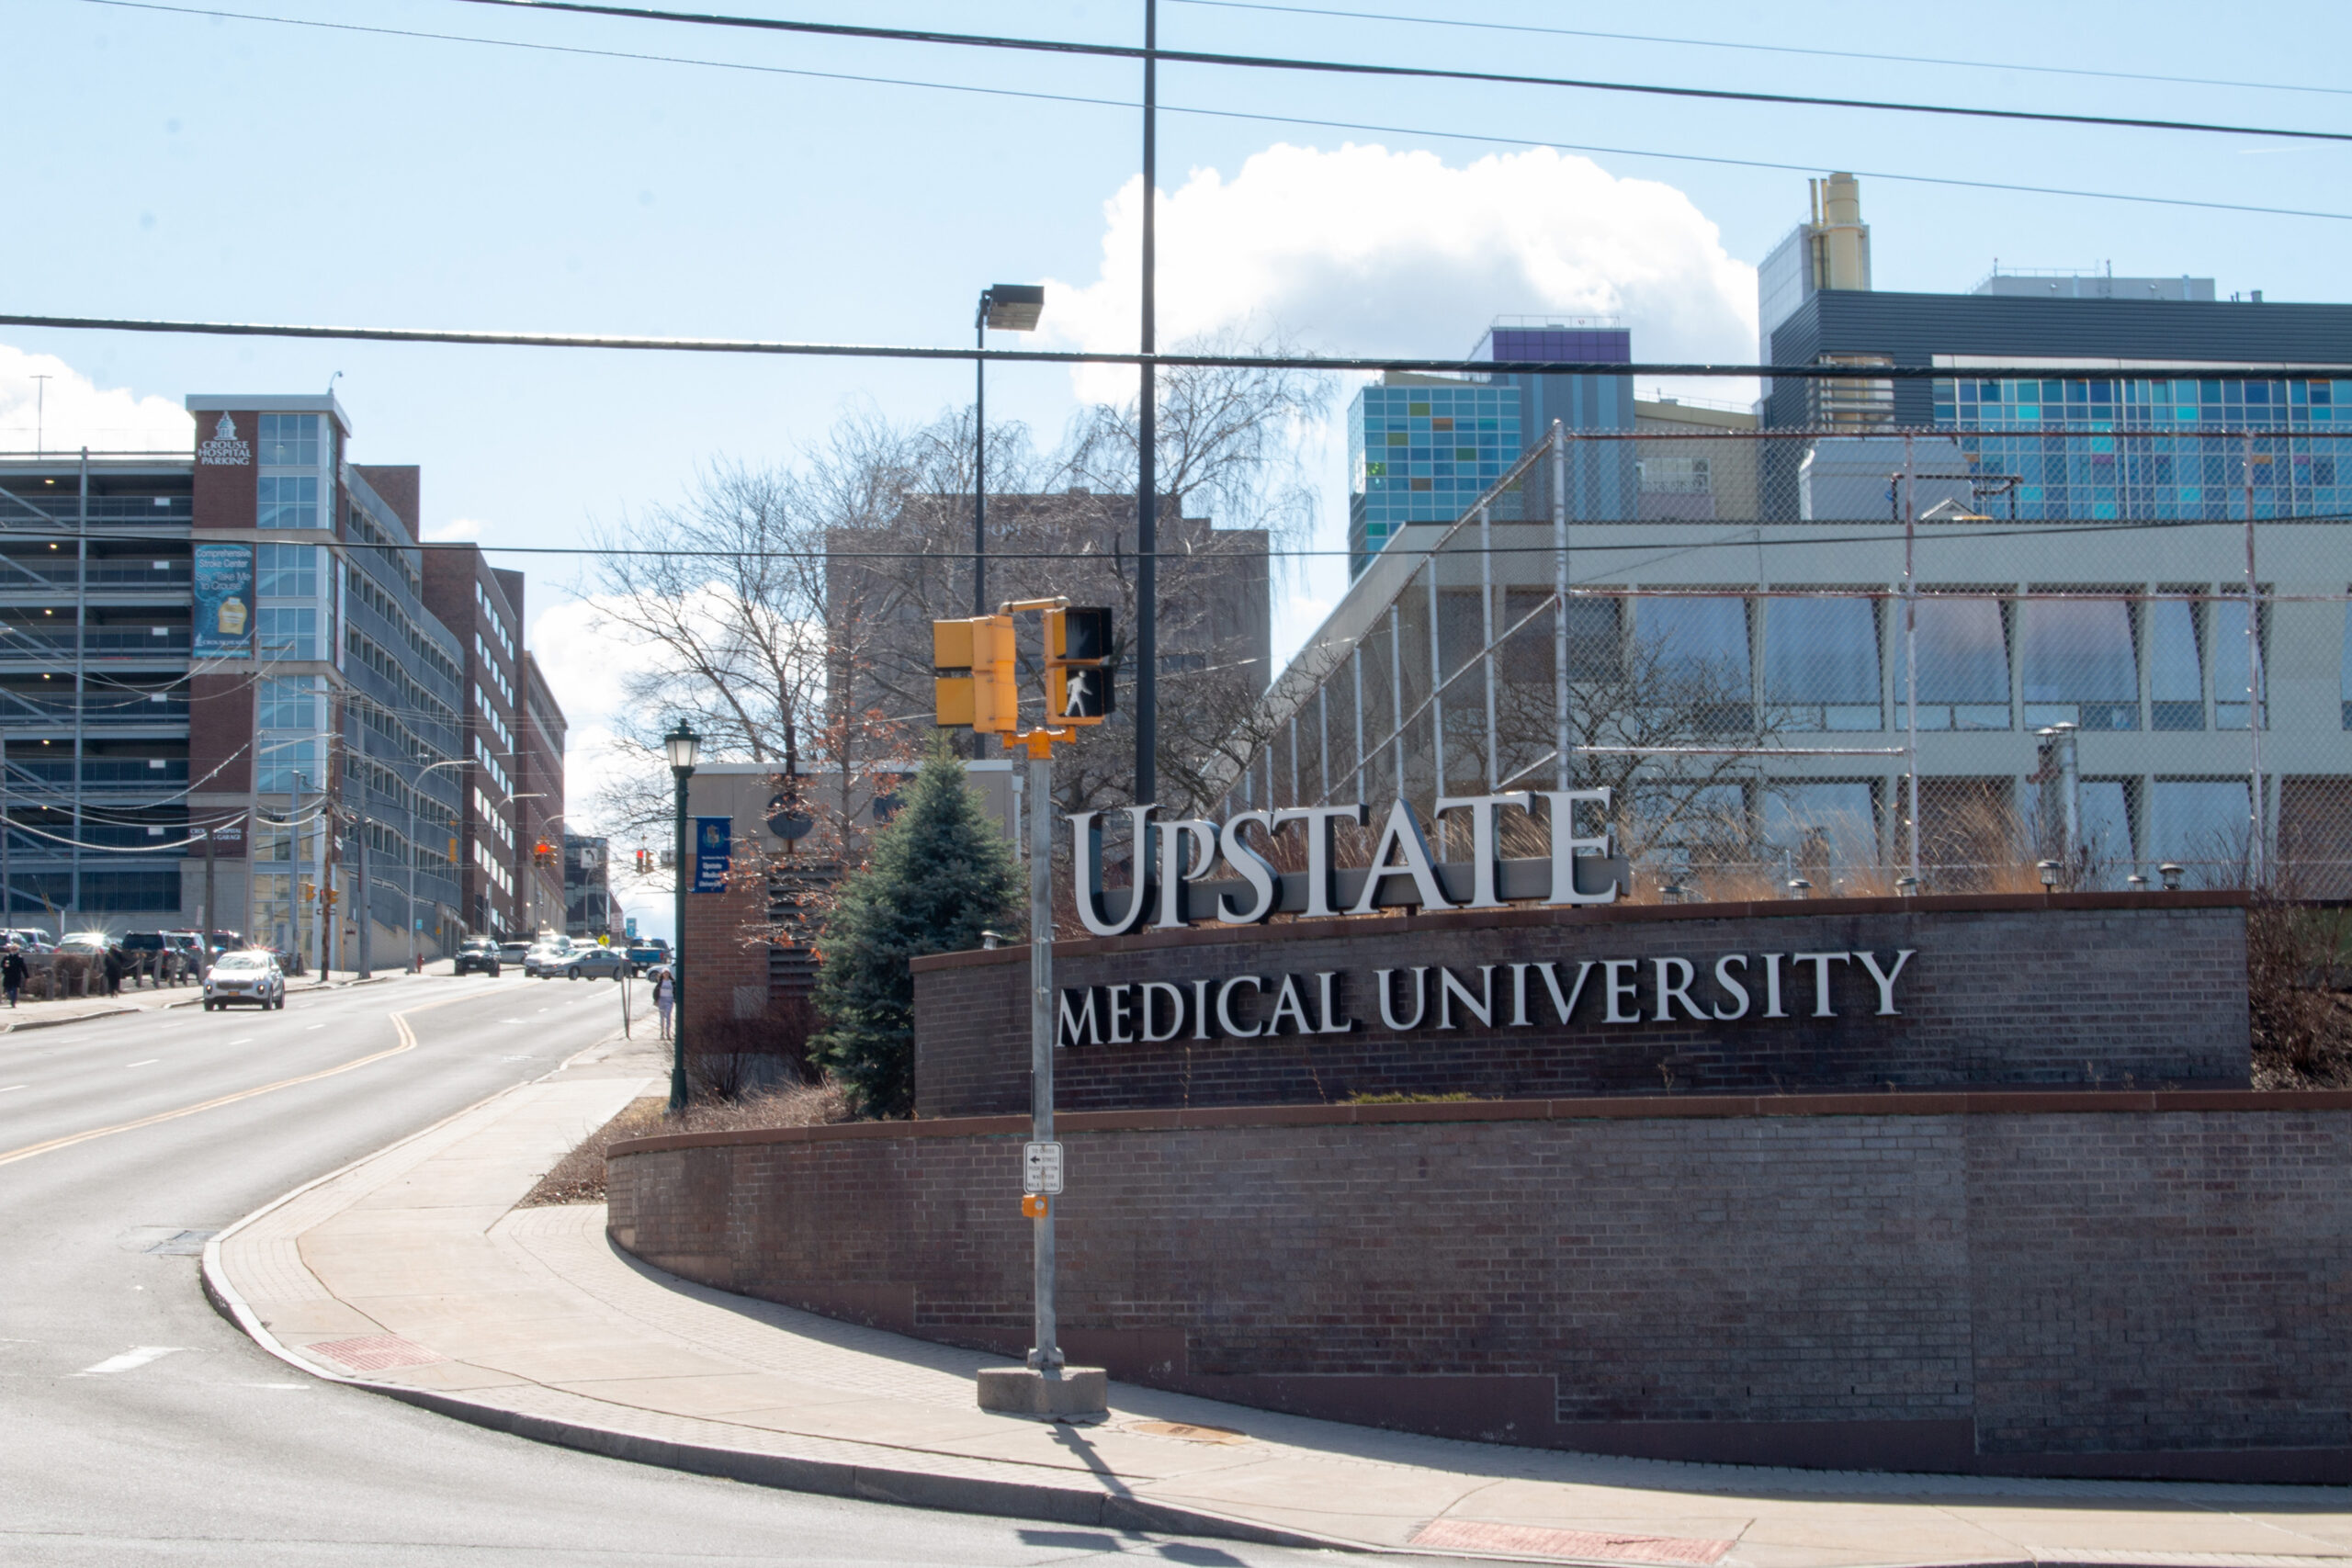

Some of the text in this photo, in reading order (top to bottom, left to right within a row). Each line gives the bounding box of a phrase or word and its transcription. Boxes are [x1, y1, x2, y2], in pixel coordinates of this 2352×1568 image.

[202, 440, 249, 449] CROUSE
[198, 448, 252, 457] HOSPITAL
[201, 457, 250, 466] PARKING
[196, 548, 252, 559] Comprehensive
[198, 558, 248, 568] Stroke Center
[236, 572, 252, 581] Me
[1065, 786, 1618, 936] UPSTATE
[1056, 948, 1917, 1048] MEDICAL UNIVERSITY
